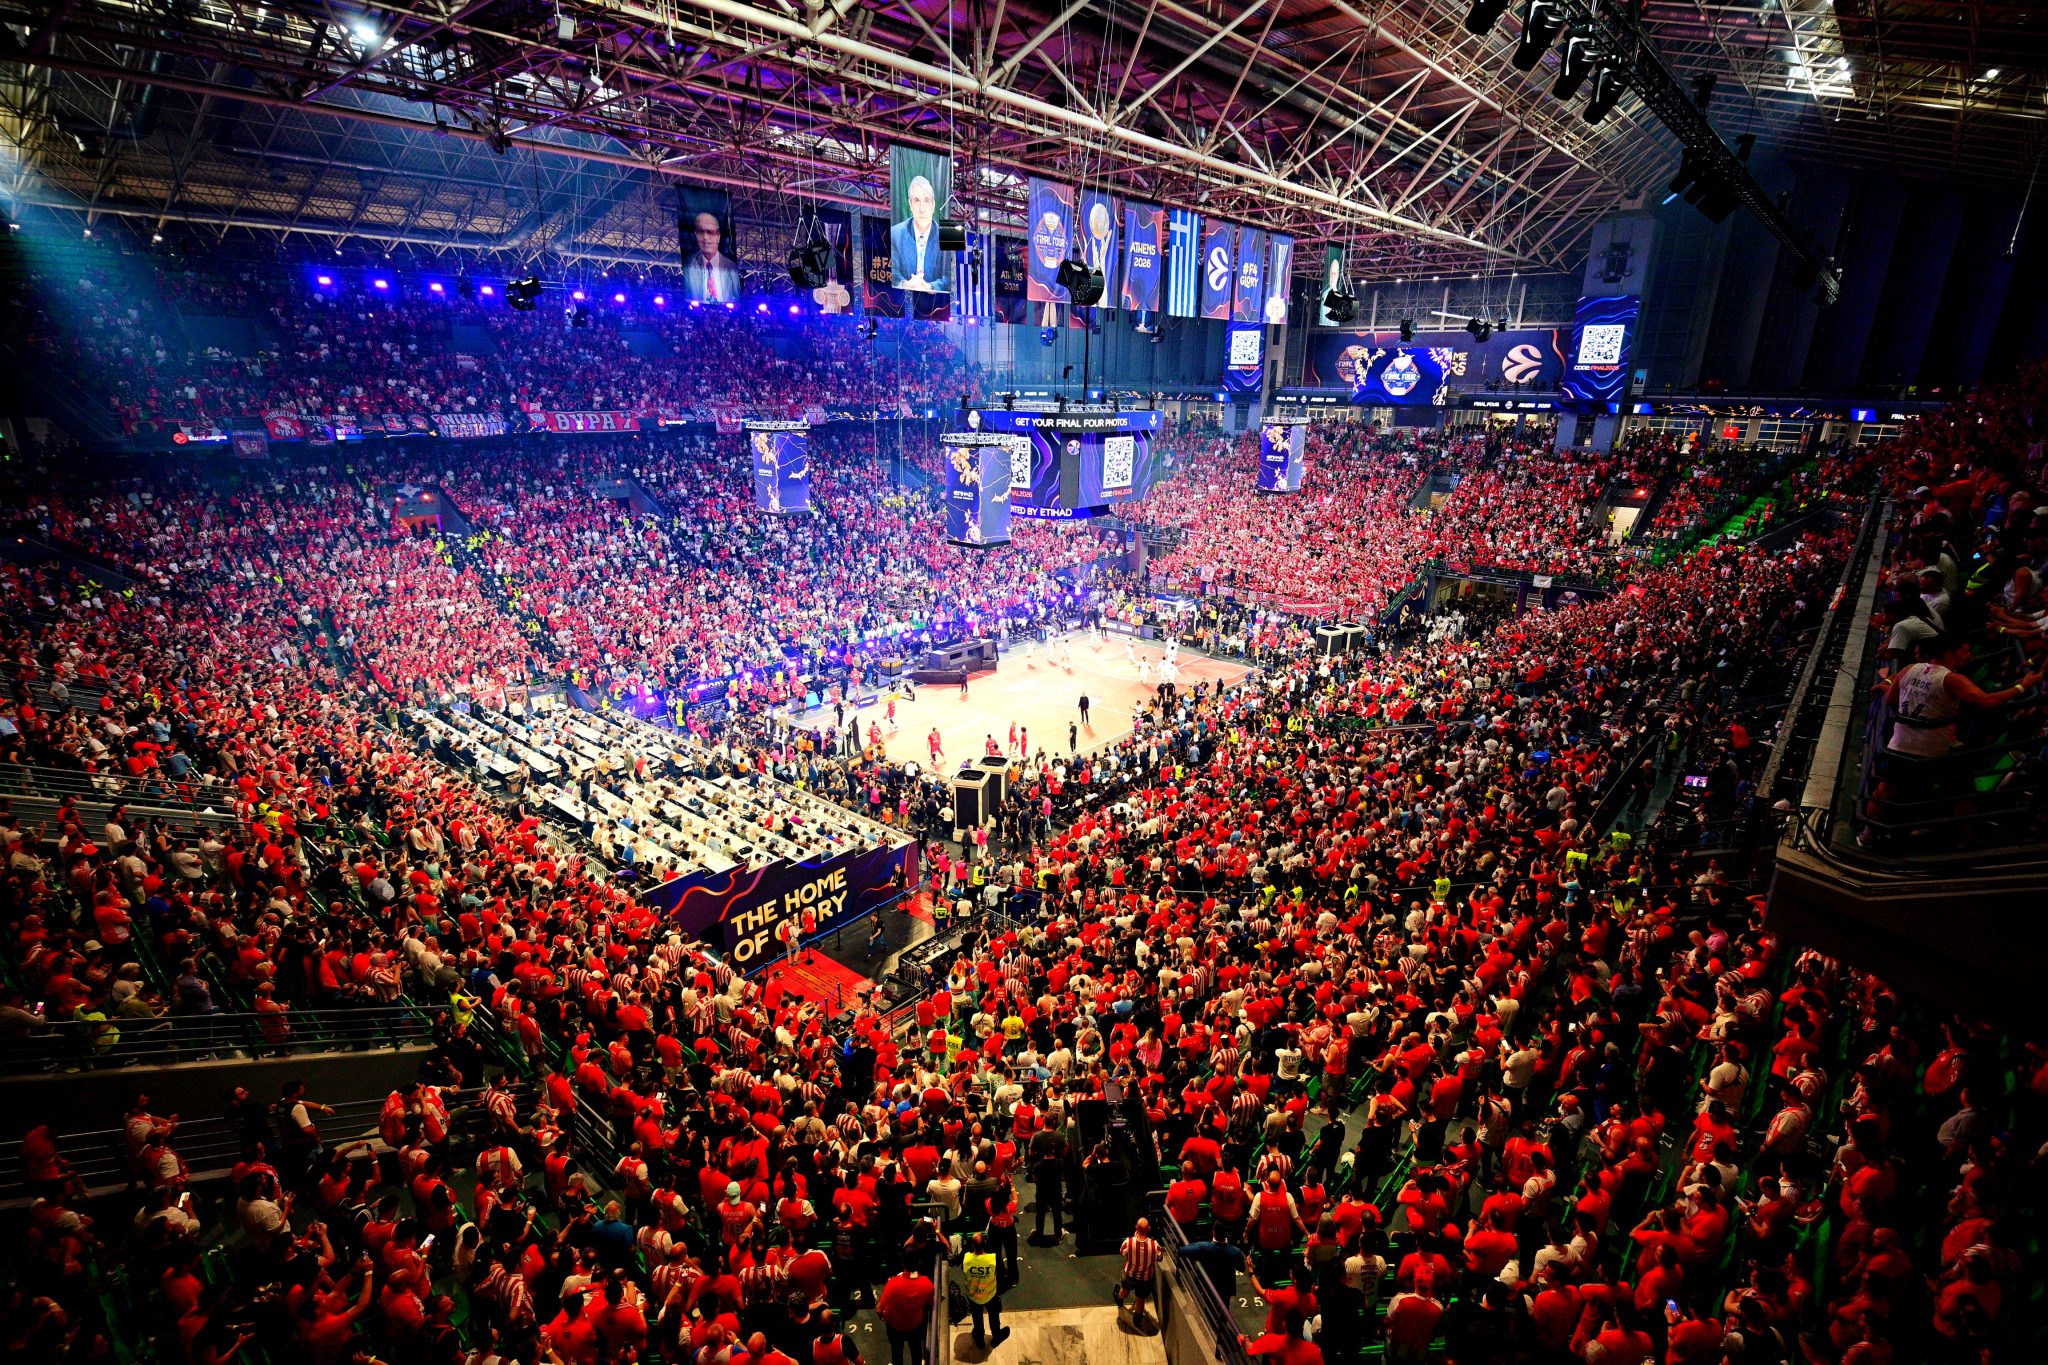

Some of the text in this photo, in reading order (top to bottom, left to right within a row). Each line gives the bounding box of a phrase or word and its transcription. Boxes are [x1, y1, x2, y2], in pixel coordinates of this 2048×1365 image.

[1130, 241, 1156, 256] ATHENS
[1134, 257, 1151, 269] 2026
[1243, 262, 1257, 277] #F4
[869, 270, 892, 284] GLOR
[1240, 275, 1259, 289] GLORY
[555, 413, 616, 430] ΘΥΡΑ
[1015, 417, 1128, 428] GET YOUR FINAL FOUR PHOTOS
[1027, 507, 1038, 516] BY
[1040, 508, 1073, 517] ETIHAD
[730, 867, 847, 936] THE HOME
[734, 932, 769, 962] OF
[969, 1266, 991, 1275] CSI
